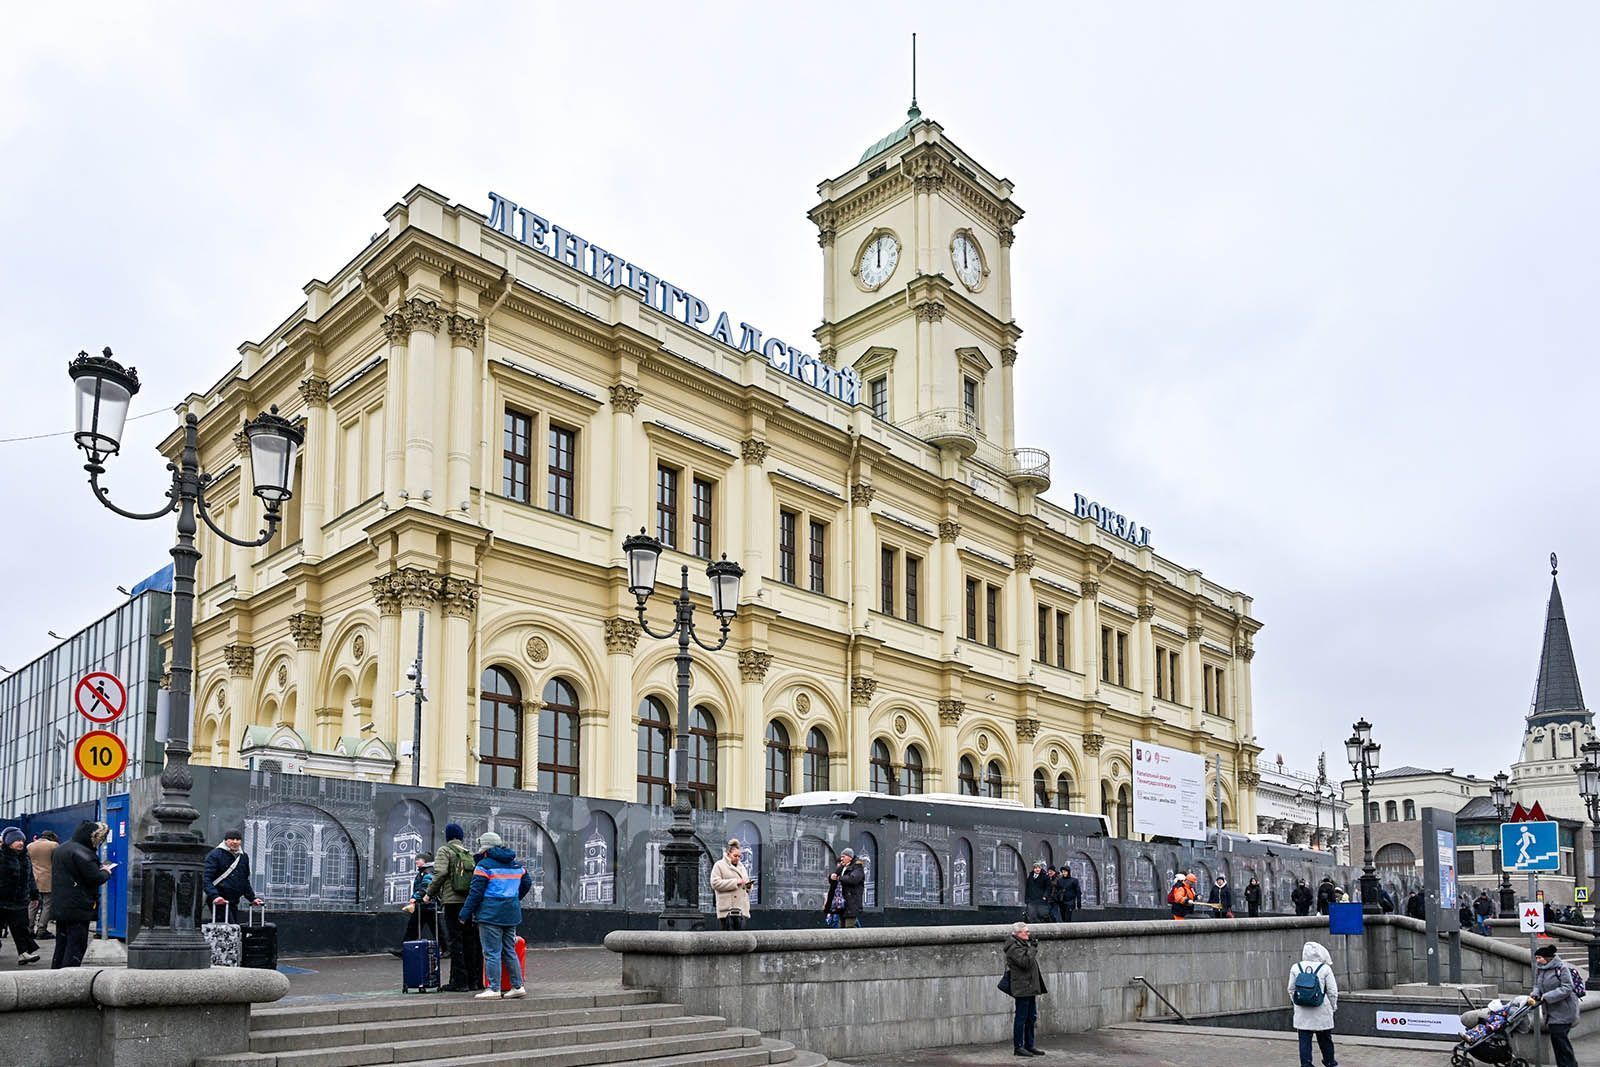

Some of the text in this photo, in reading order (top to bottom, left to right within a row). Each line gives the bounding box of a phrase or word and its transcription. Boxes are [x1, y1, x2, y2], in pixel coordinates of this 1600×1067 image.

[487, 191, 862, 405] ЛЕНИНГРАДСКИЙ
[1074, 493, 1152, 545] ВОКЗАЛ
[89, 746, 113, 767] 10
